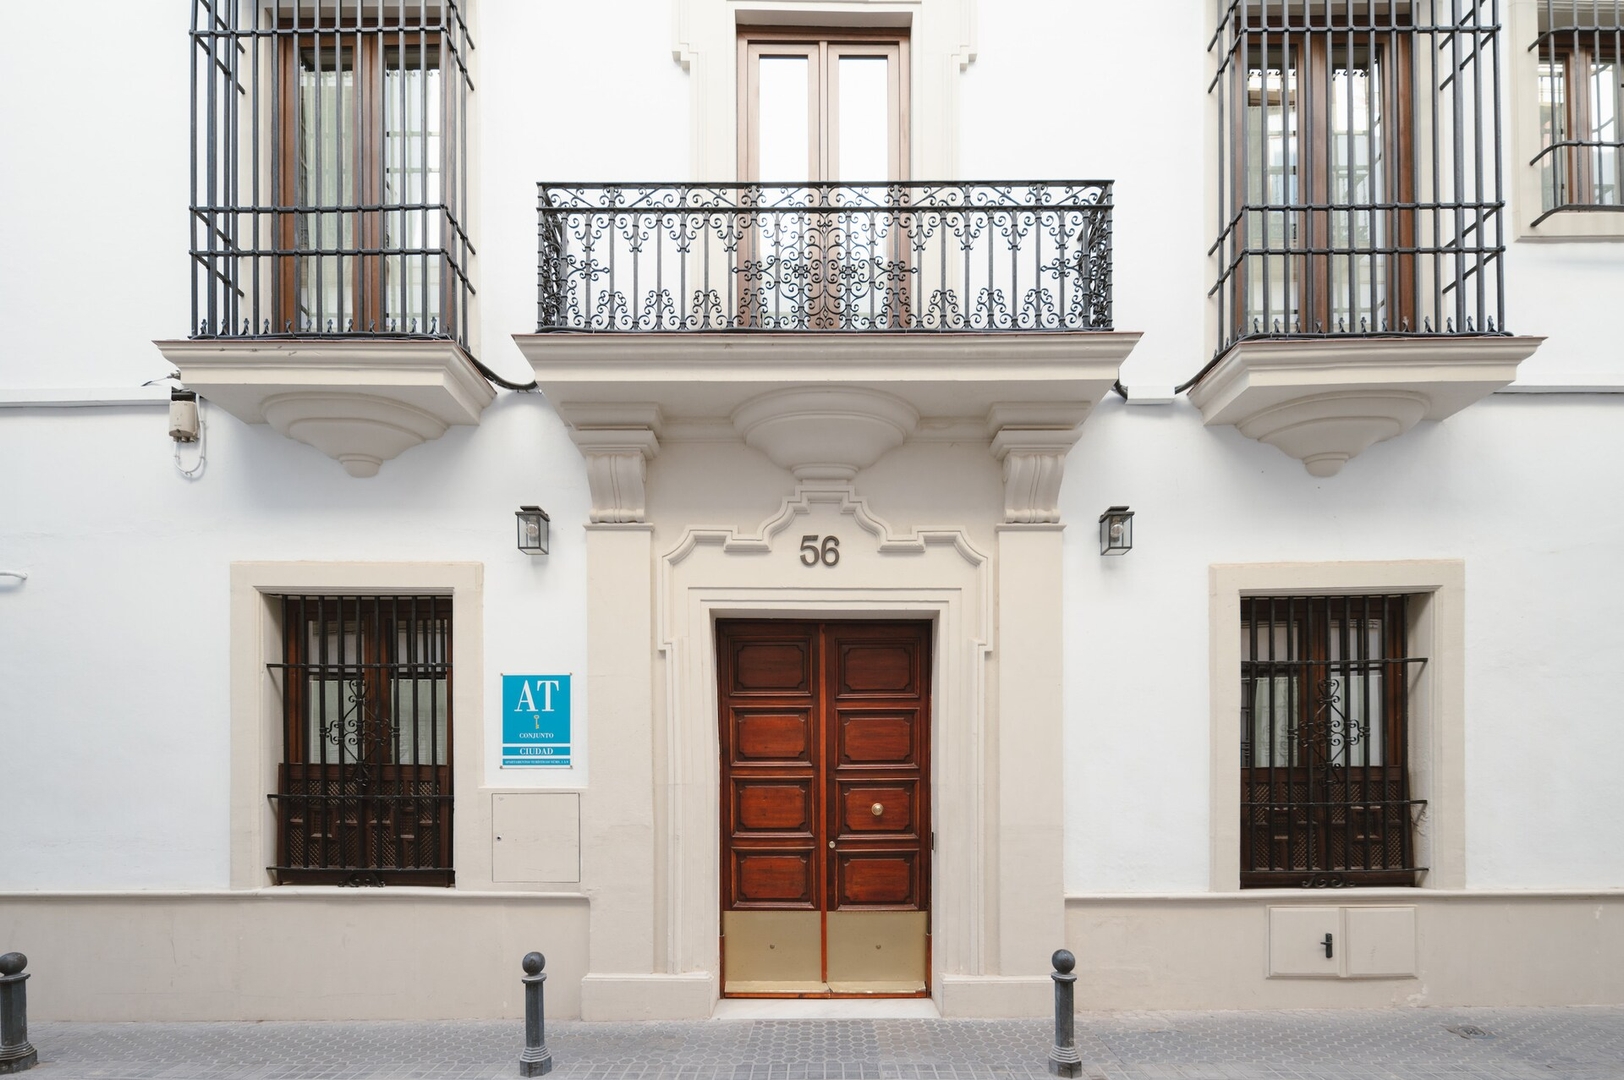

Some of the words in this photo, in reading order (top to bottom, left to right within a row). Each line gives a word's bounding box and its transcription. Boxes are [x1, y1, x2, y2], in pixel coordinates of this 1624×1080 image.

[800, 535, 840, 567] 56
[514, 679, 559, 712] AT
[519, 747, 554, 755] CIUDAD
